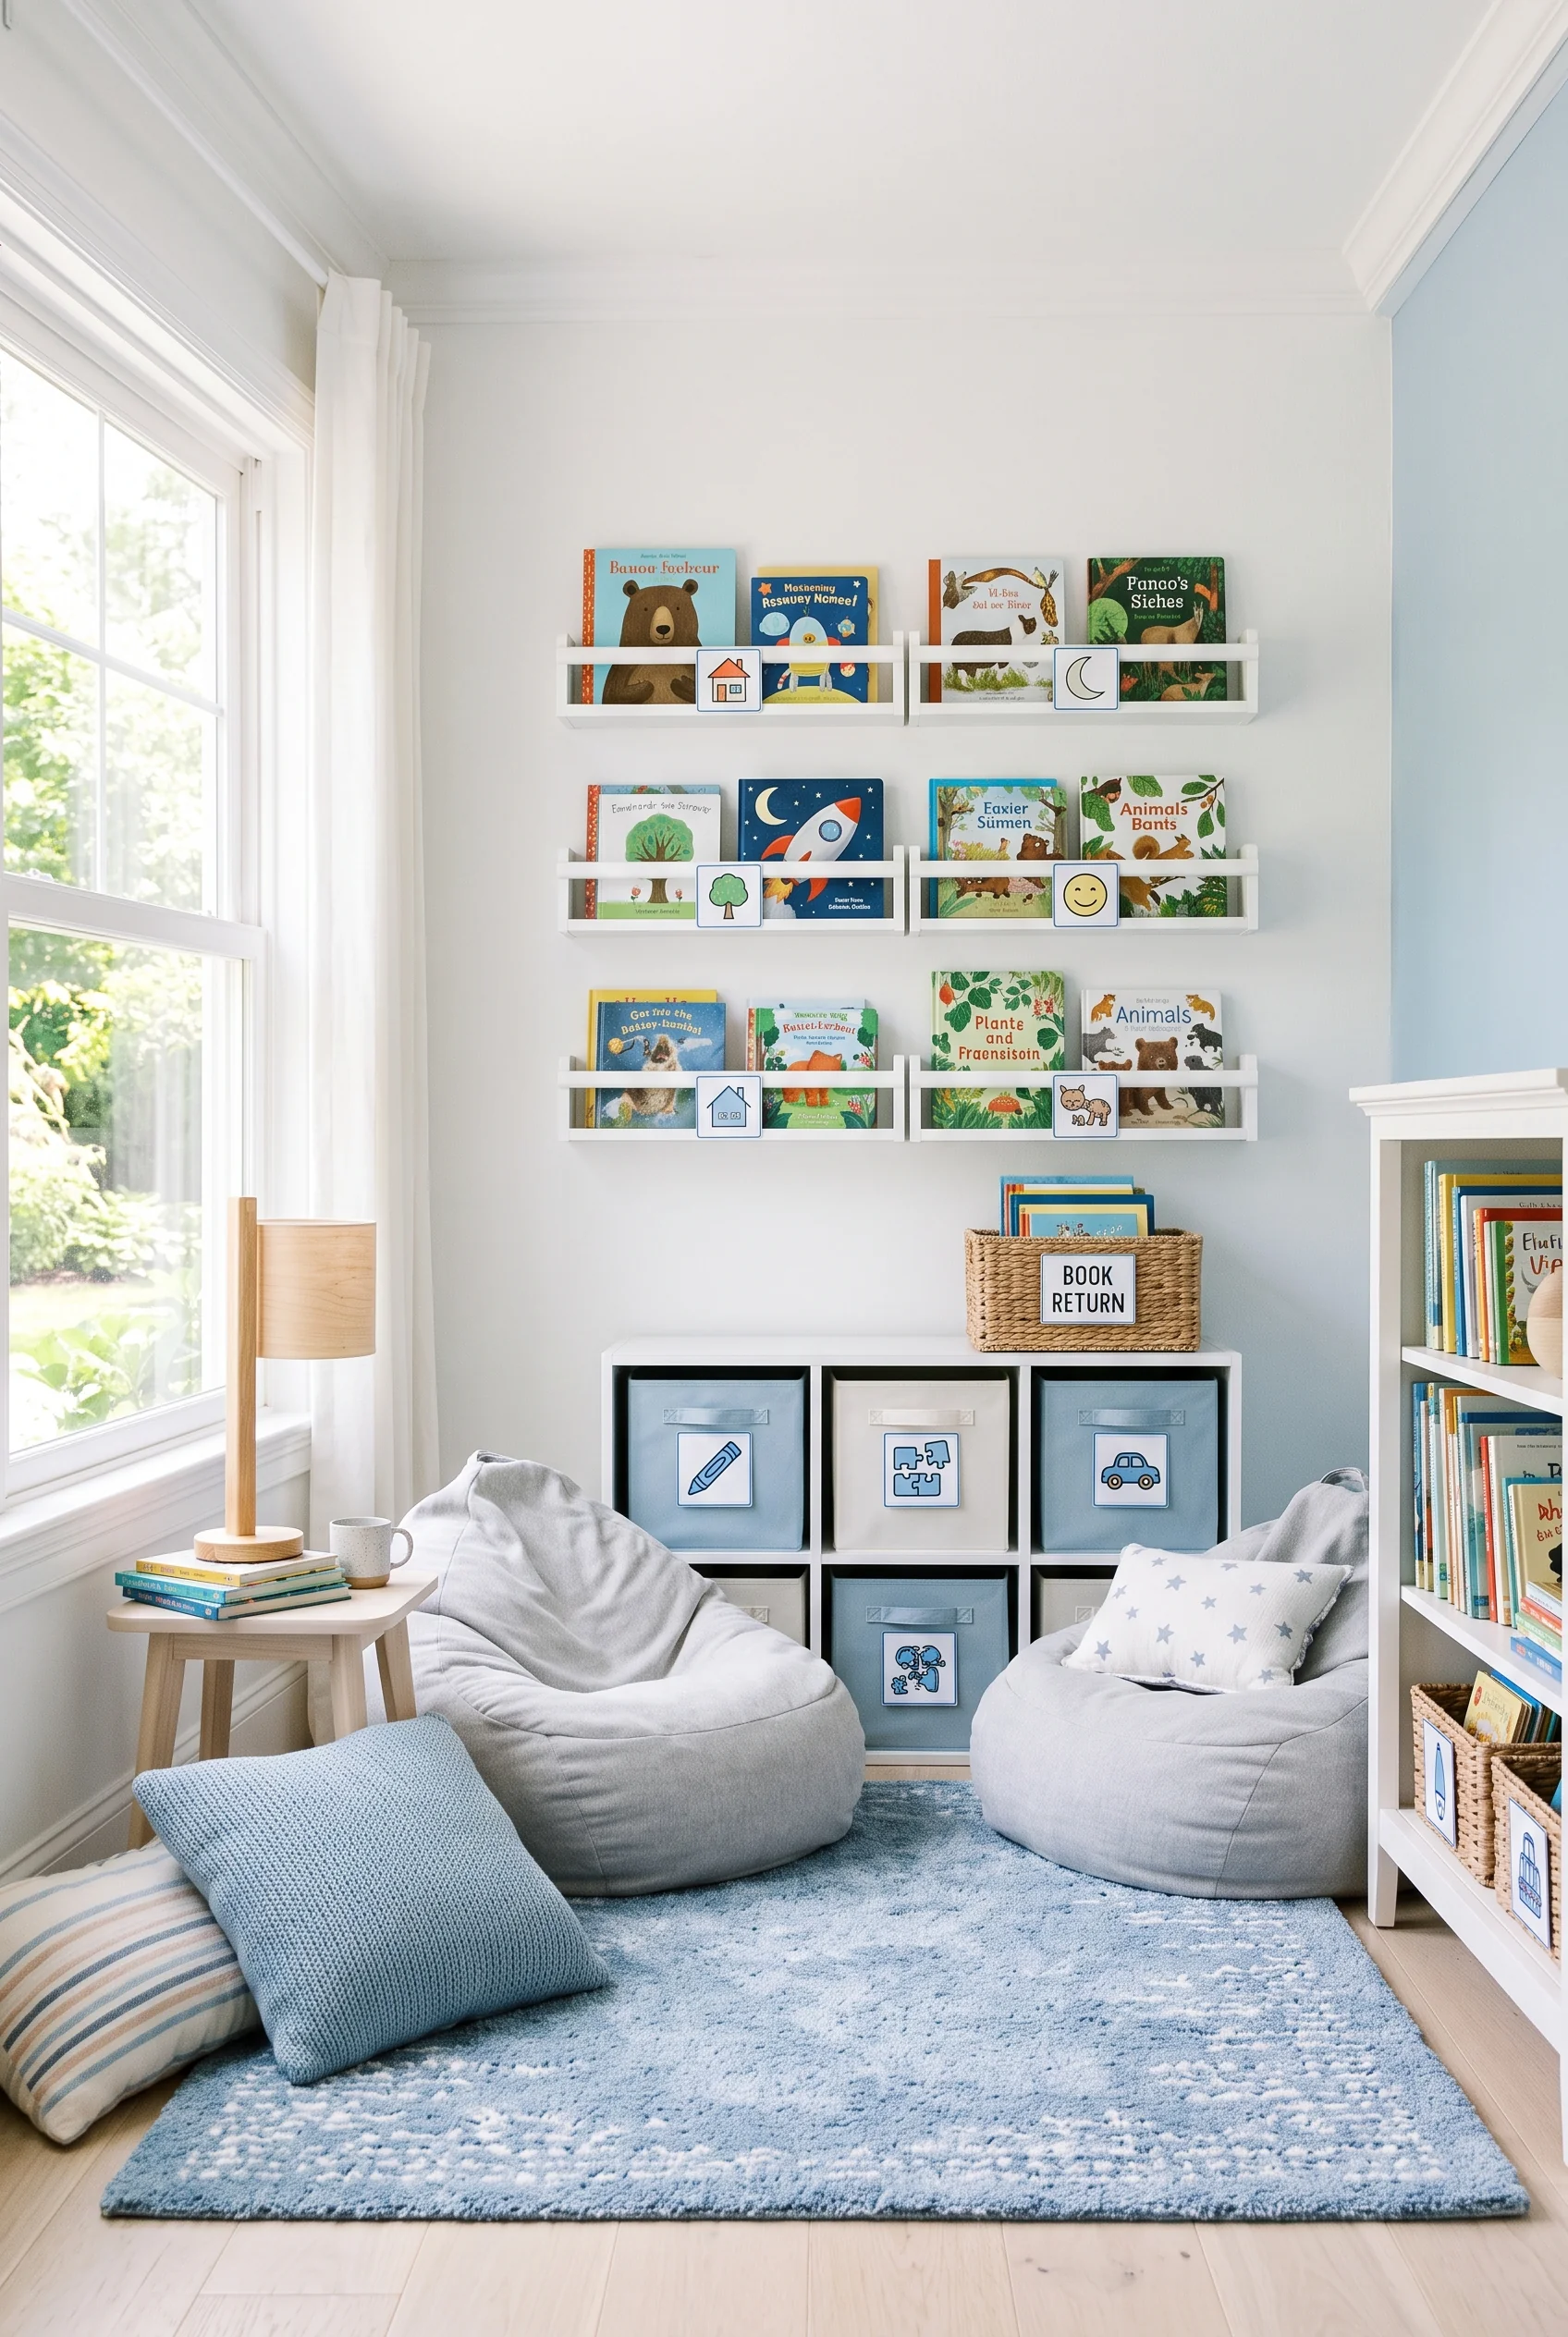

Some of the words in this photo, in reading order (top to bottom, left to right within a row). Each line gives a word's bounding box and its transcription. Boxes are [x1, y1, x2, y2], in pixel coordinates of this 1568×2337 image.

[1120, 802, 1188, 815] Animals
[1116, 1005, 1192, 1023] Animals
[975, 1015, 1024, 1031] Plante
[986, 1031, 1013, 1045] and
[1063, 1265, 1113, 1286] BOOK
[1052, 1292, 1124, 1314] RETURN
